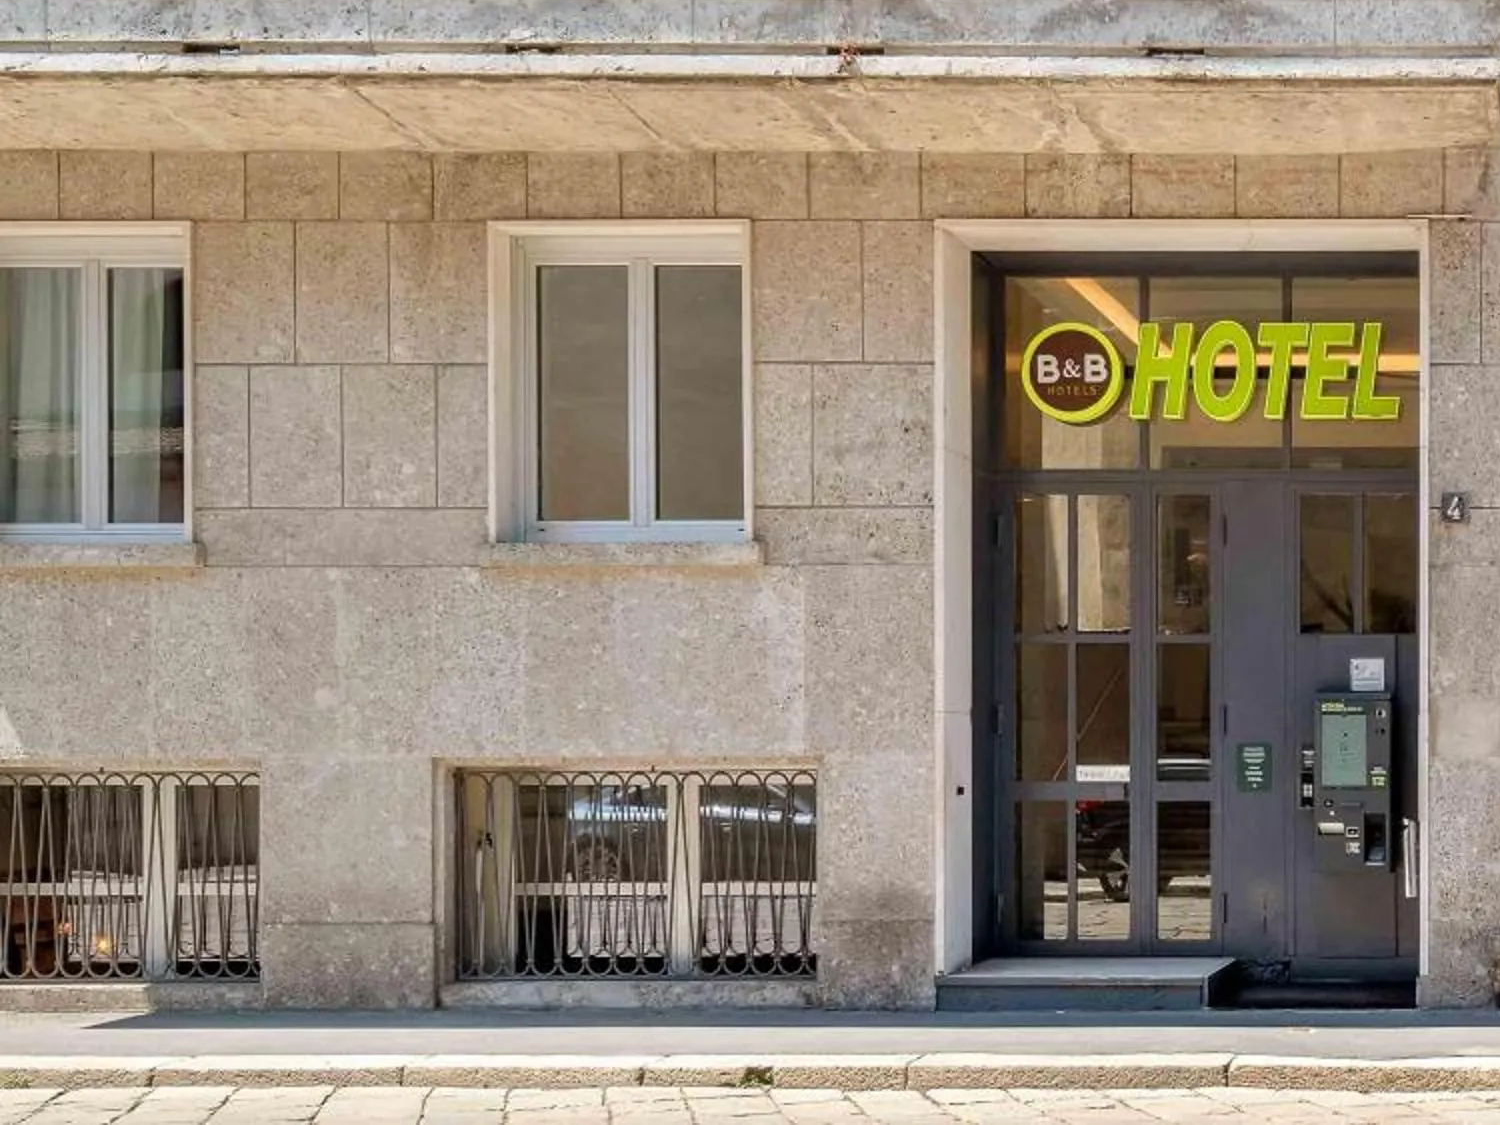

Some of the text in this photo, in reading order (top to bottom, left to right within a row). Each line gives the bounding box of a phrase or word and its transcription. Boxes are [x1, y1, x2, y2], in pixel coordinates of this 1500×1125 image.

[1037, 353, 1108, 384] B&B
[1129, 320, 1400, 421] HOTEL
[1047, 385, 1097, 396] HOTELS
